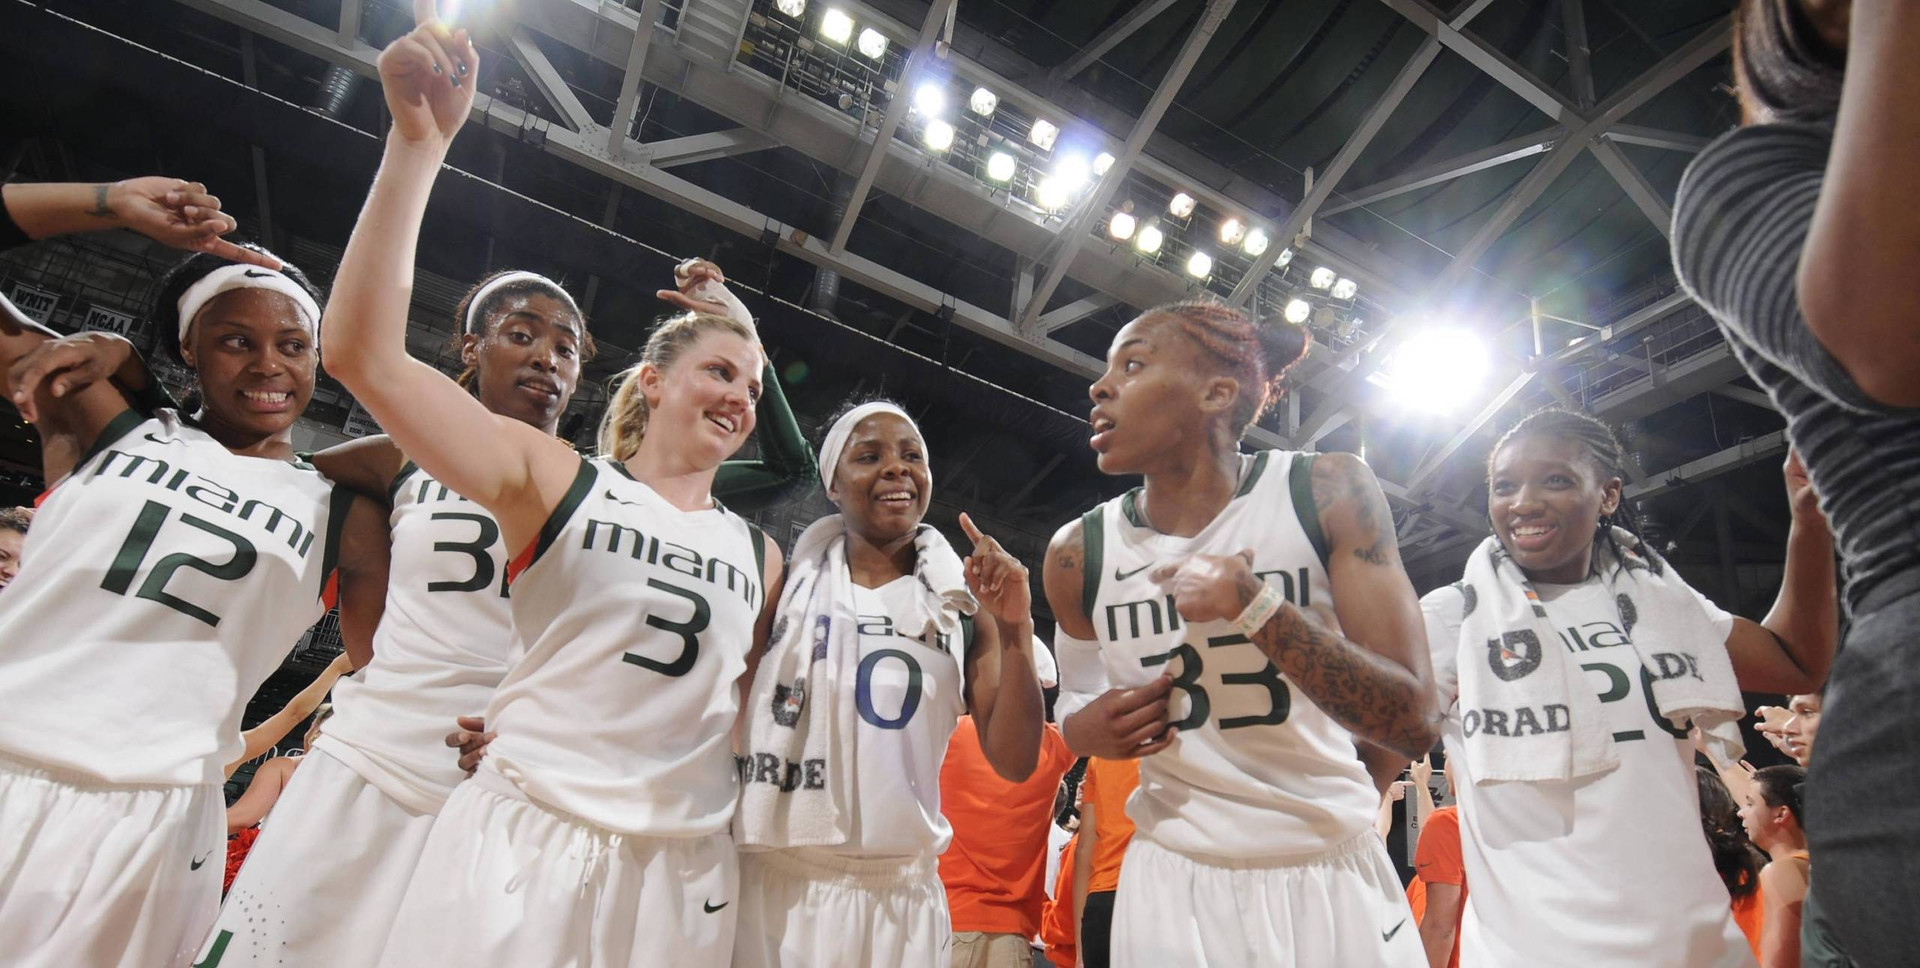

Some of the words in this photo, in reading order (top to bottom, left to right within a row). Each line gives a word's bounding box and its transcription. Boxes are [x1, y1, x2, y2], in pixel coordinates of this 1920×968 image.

[16, 289, 53, 311] WNIT
[87, 311, 126, 334] NCAA
[100, 499, 257, 628] 12
[428, 512, 510, 598] 3
[622, 578, 711, 678] 3
[1106, 567, 1310, 641] mii
[855, 649, 922, 730] 0
[1140, 633, 1291, 730] 33
[1463, 704, 1570, 738] ORAD
